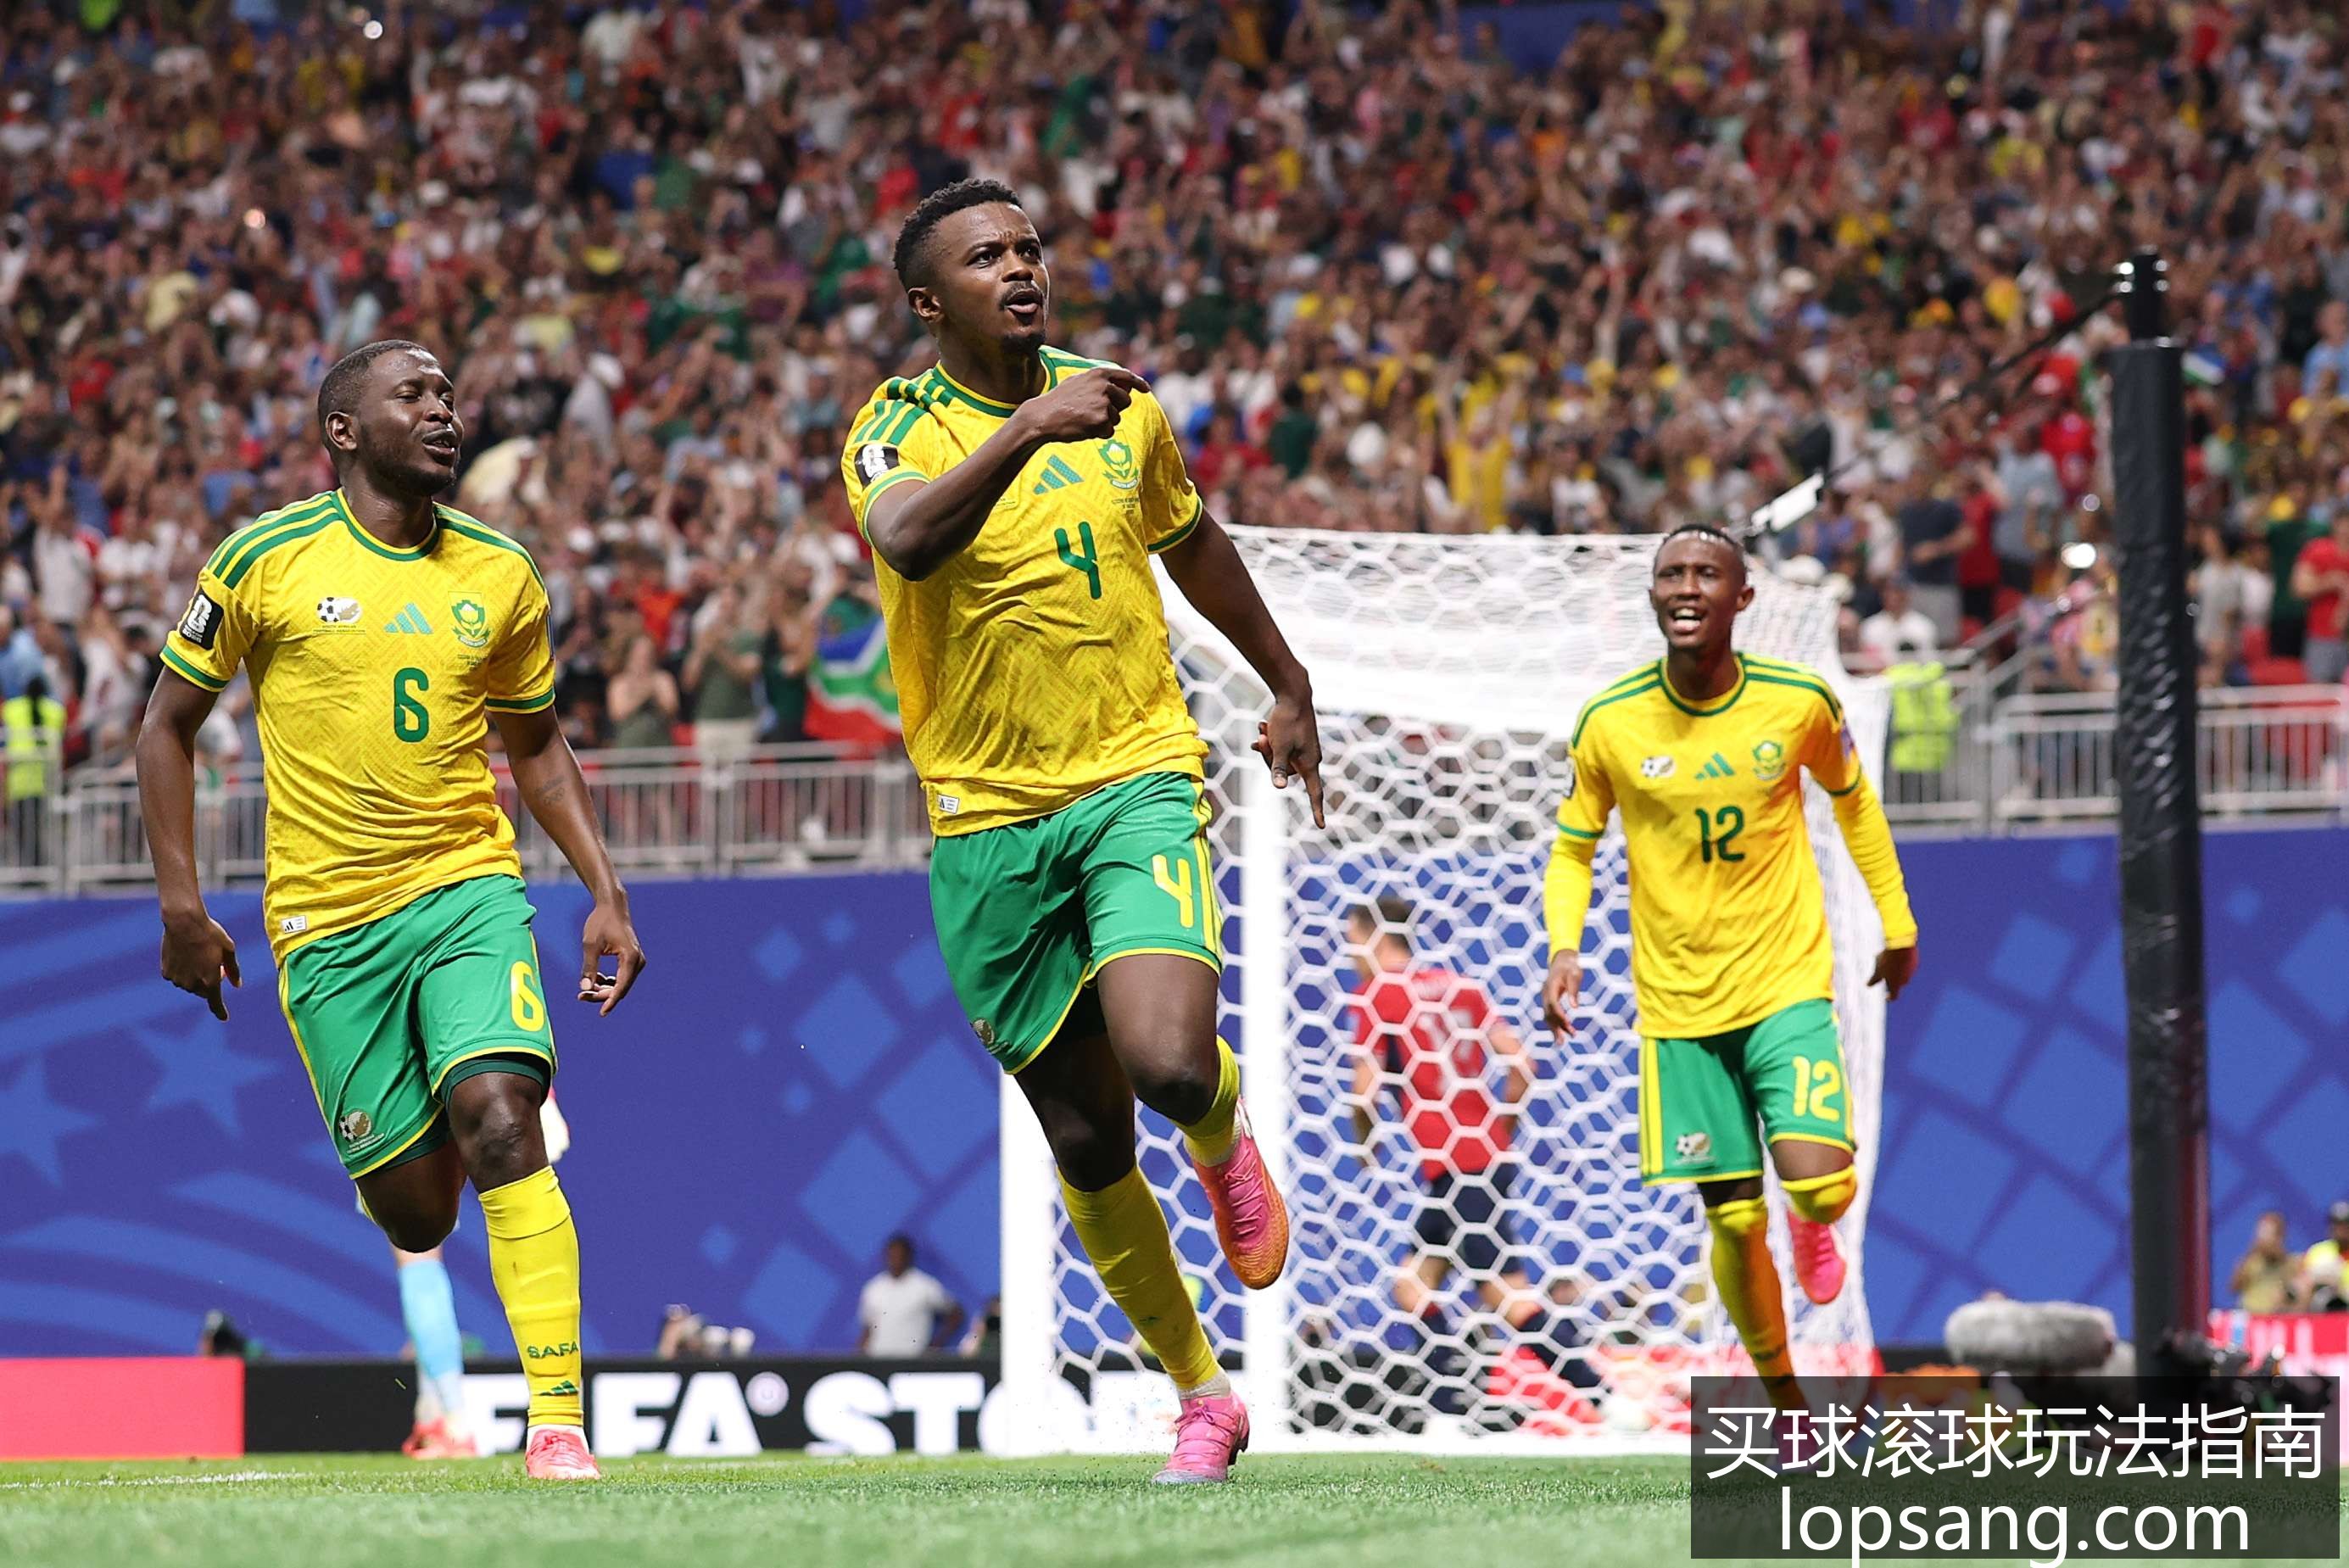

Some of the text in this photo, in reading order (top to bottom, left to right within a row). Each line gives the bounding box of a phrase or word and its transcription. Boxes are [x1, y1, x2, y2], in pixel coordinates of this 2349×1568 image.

[1054, 521, 1102, 600] 4
[393, 667, 430, 743] 6
[1693, 805, 1746, 863] 12
[1152, 854, 1195, 929] 4
[510, 959, 545, 1033] 6
[1792, 1055, 1841, 1123] 12
[527, 1341, 579, 1359] SAFA
[462, 1371, 762, 1457] FFA
